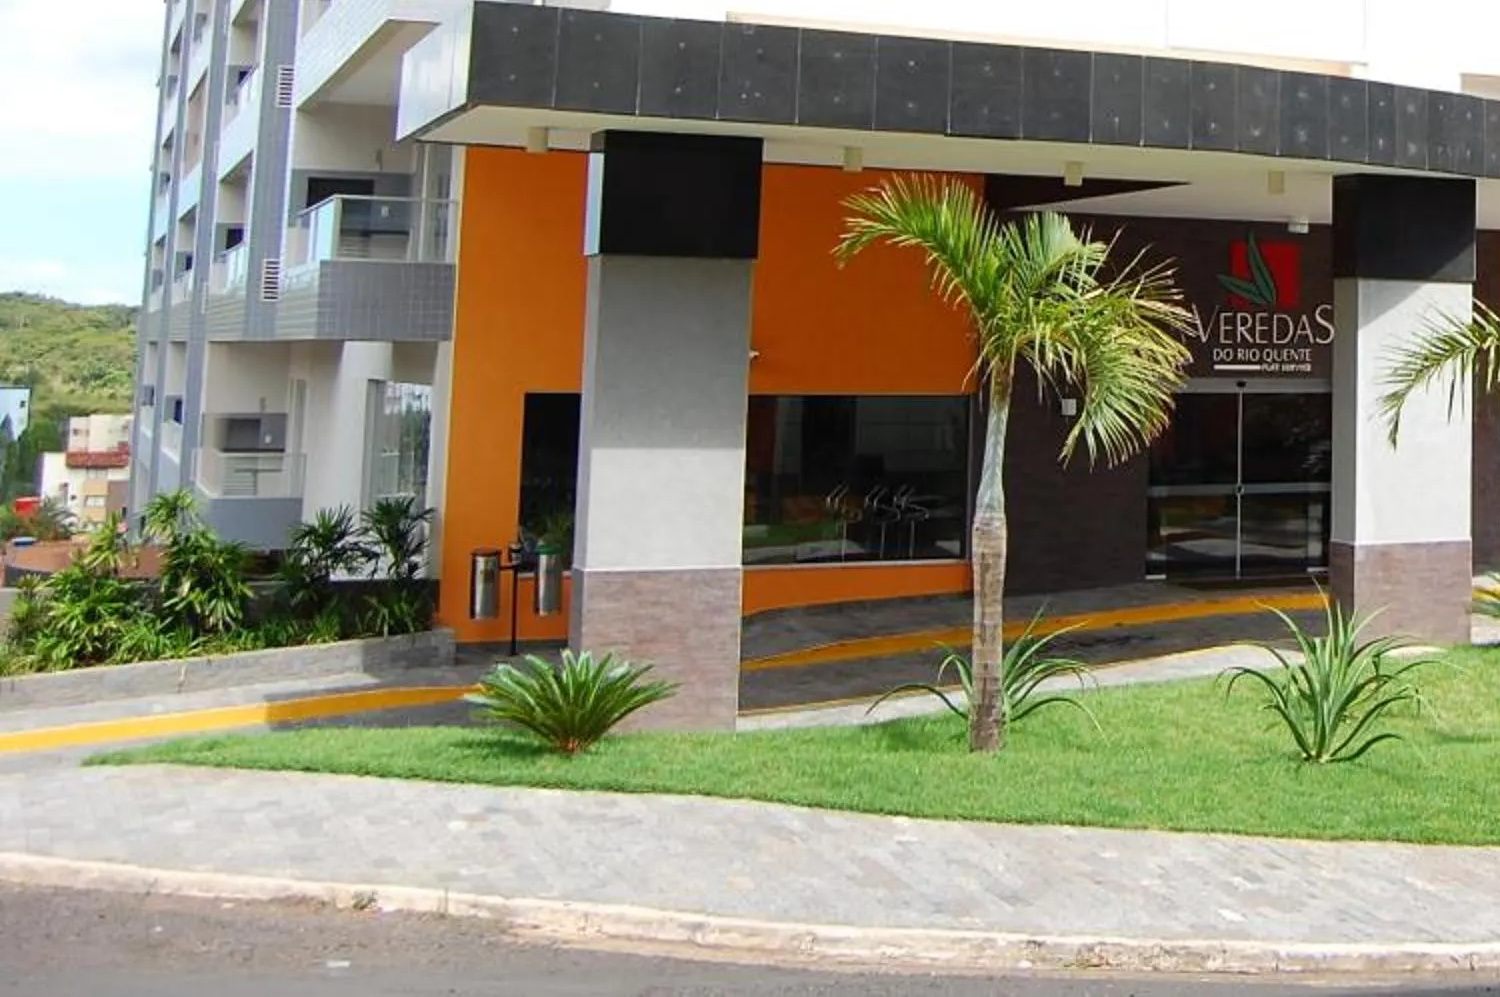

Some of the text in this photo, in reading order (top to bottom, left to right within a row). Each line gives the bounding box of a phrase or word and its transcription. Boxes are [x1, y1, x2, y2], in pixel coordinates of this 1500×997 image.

[1191, 303, 1335, 345] VEREDAS
[1213, 348, 1312, 362] DO RIO QUENTE
